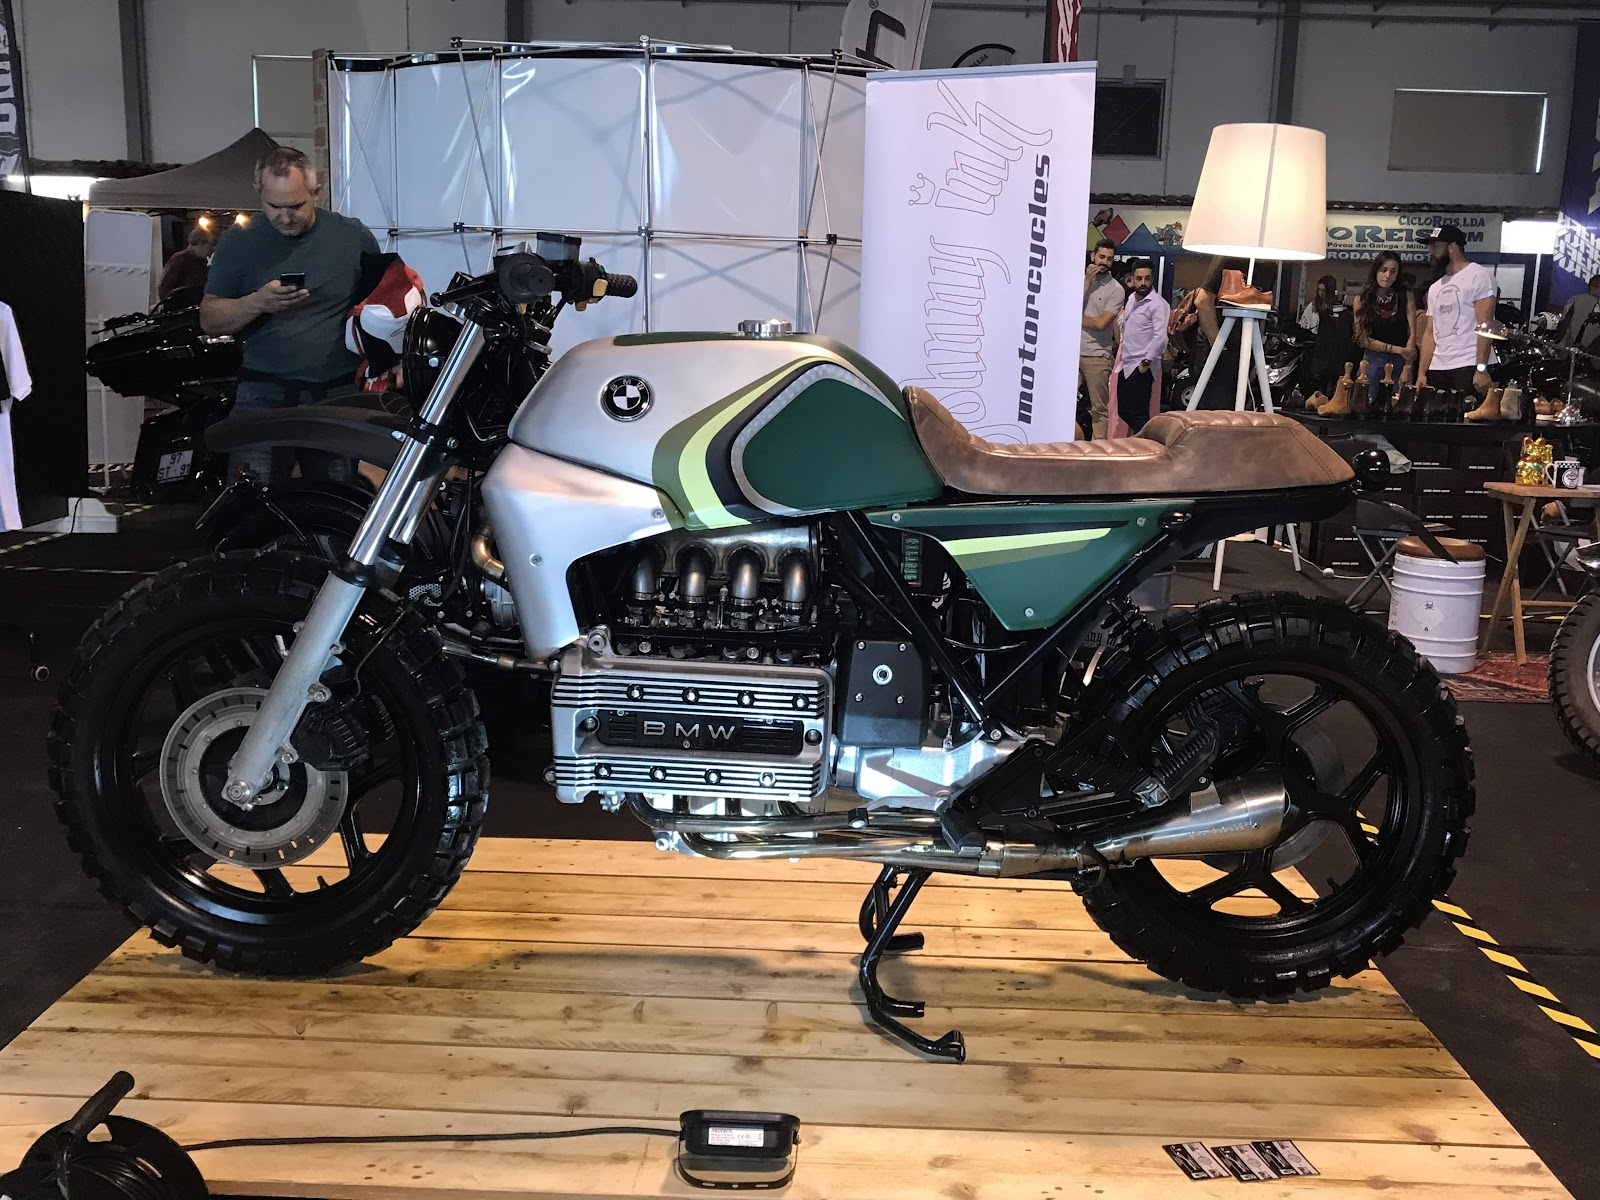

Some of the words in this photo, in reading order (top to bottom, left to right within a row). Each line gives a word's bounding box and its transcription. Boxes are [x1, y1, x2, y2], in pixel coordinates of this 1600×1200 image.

[908, 79, 1053, 216] ink
[1326, 225, 1437, 243] OREIS
[1018, 153, 1050, 425] motorcycles
[609, 378, 646, 391] BMW
[643, 720, 736, 740] BMW
